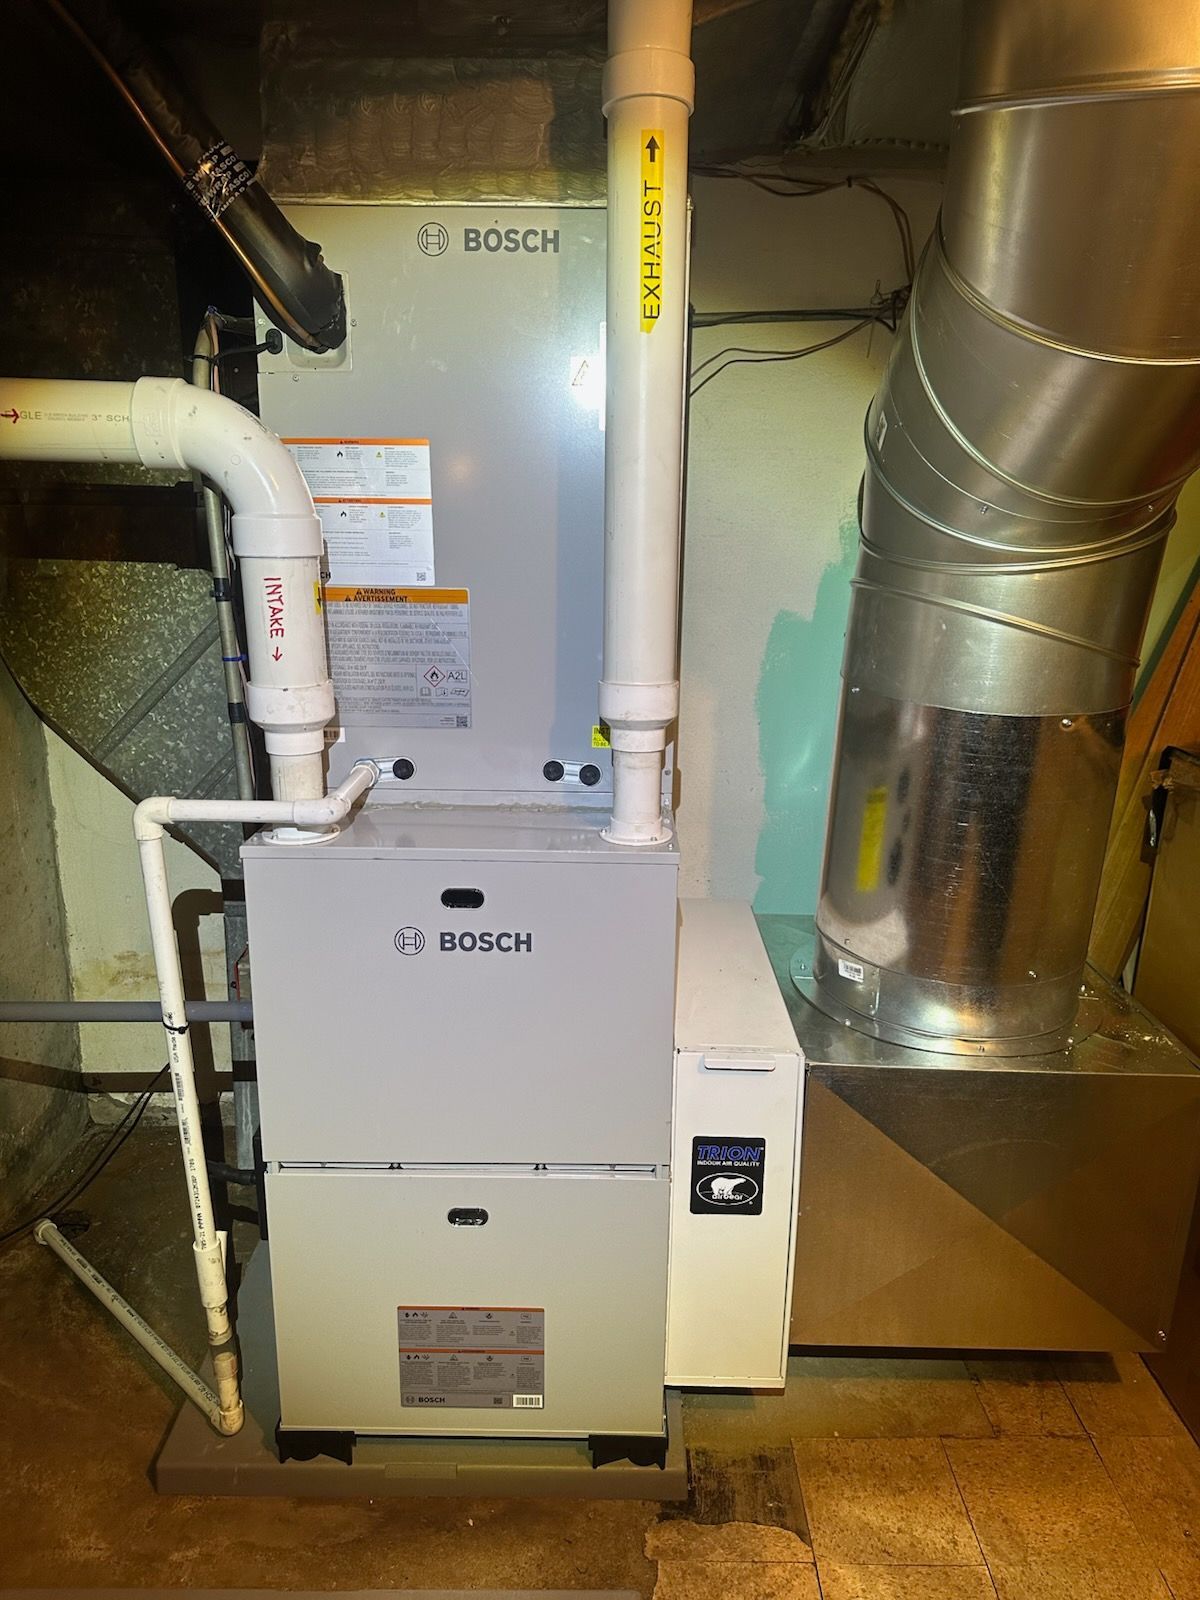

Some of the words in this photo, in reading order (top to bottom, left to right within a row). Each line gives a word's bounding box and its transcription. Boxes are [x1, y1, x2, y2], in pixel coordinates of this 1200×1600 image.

[464, 228, 560, 253] BOSCH
[643, 179, 661, 319] EXHAUST
[106, 414, 130, 422] SCH
[353, 595, 408, 603] AVERTISSEMENT
[264, 577, 285, 639] INTAKE
[448, 671, 467, 682] A2L
[440, 932, 532, 952] BOSCH
[697, 1145, 760, 1161] TRION
[418, 1396, 446, 1404] BOSCH
